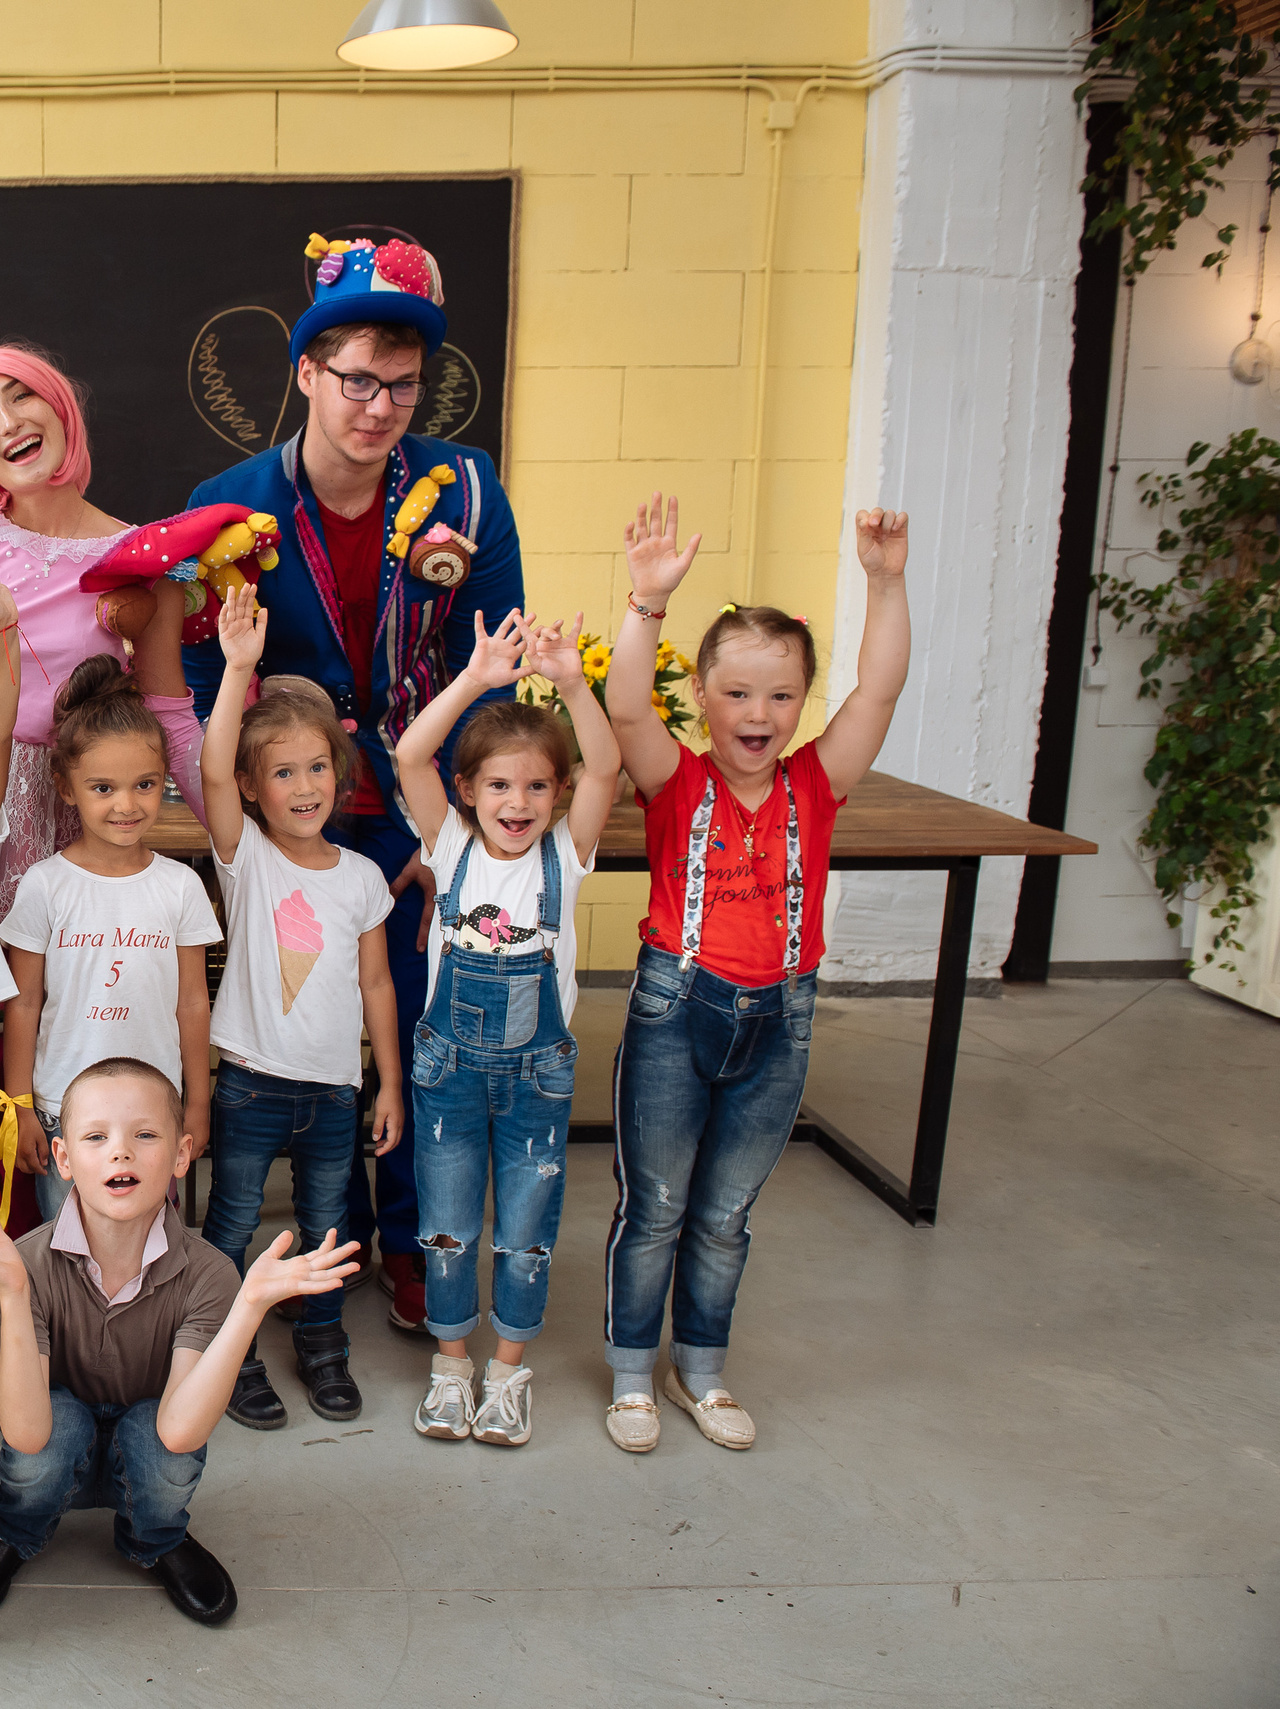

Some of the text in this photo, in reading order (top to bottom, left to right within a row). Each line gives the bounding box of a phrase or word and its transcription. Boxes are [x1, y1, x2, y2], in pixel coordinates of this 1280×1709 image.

[56, 926, 171, 950] Lara Maria
[104, 960, 124, 988] 5
[86, 1005, 130, 1021] лет
